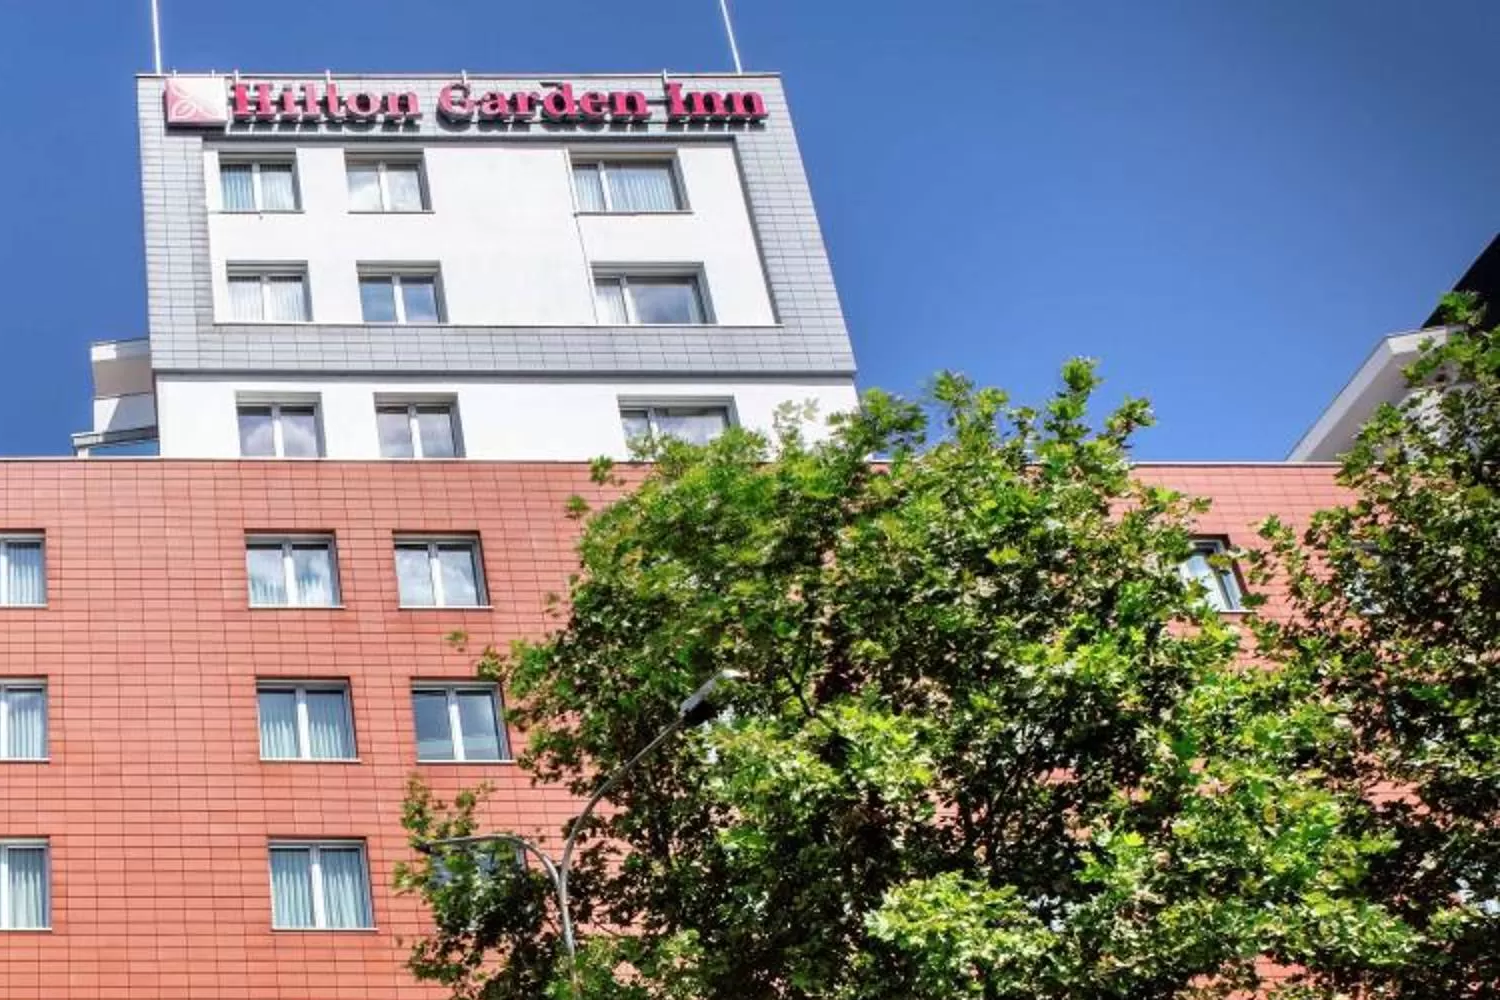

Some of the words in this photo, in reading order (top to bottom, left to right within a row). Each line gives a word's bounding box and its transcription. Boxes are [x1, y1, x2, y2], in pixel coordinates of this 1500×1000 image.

[229, 83, 423, 120] Hilton
[438, 81, 653, 120] Garden
[663, 83, 769, 119] Inn
